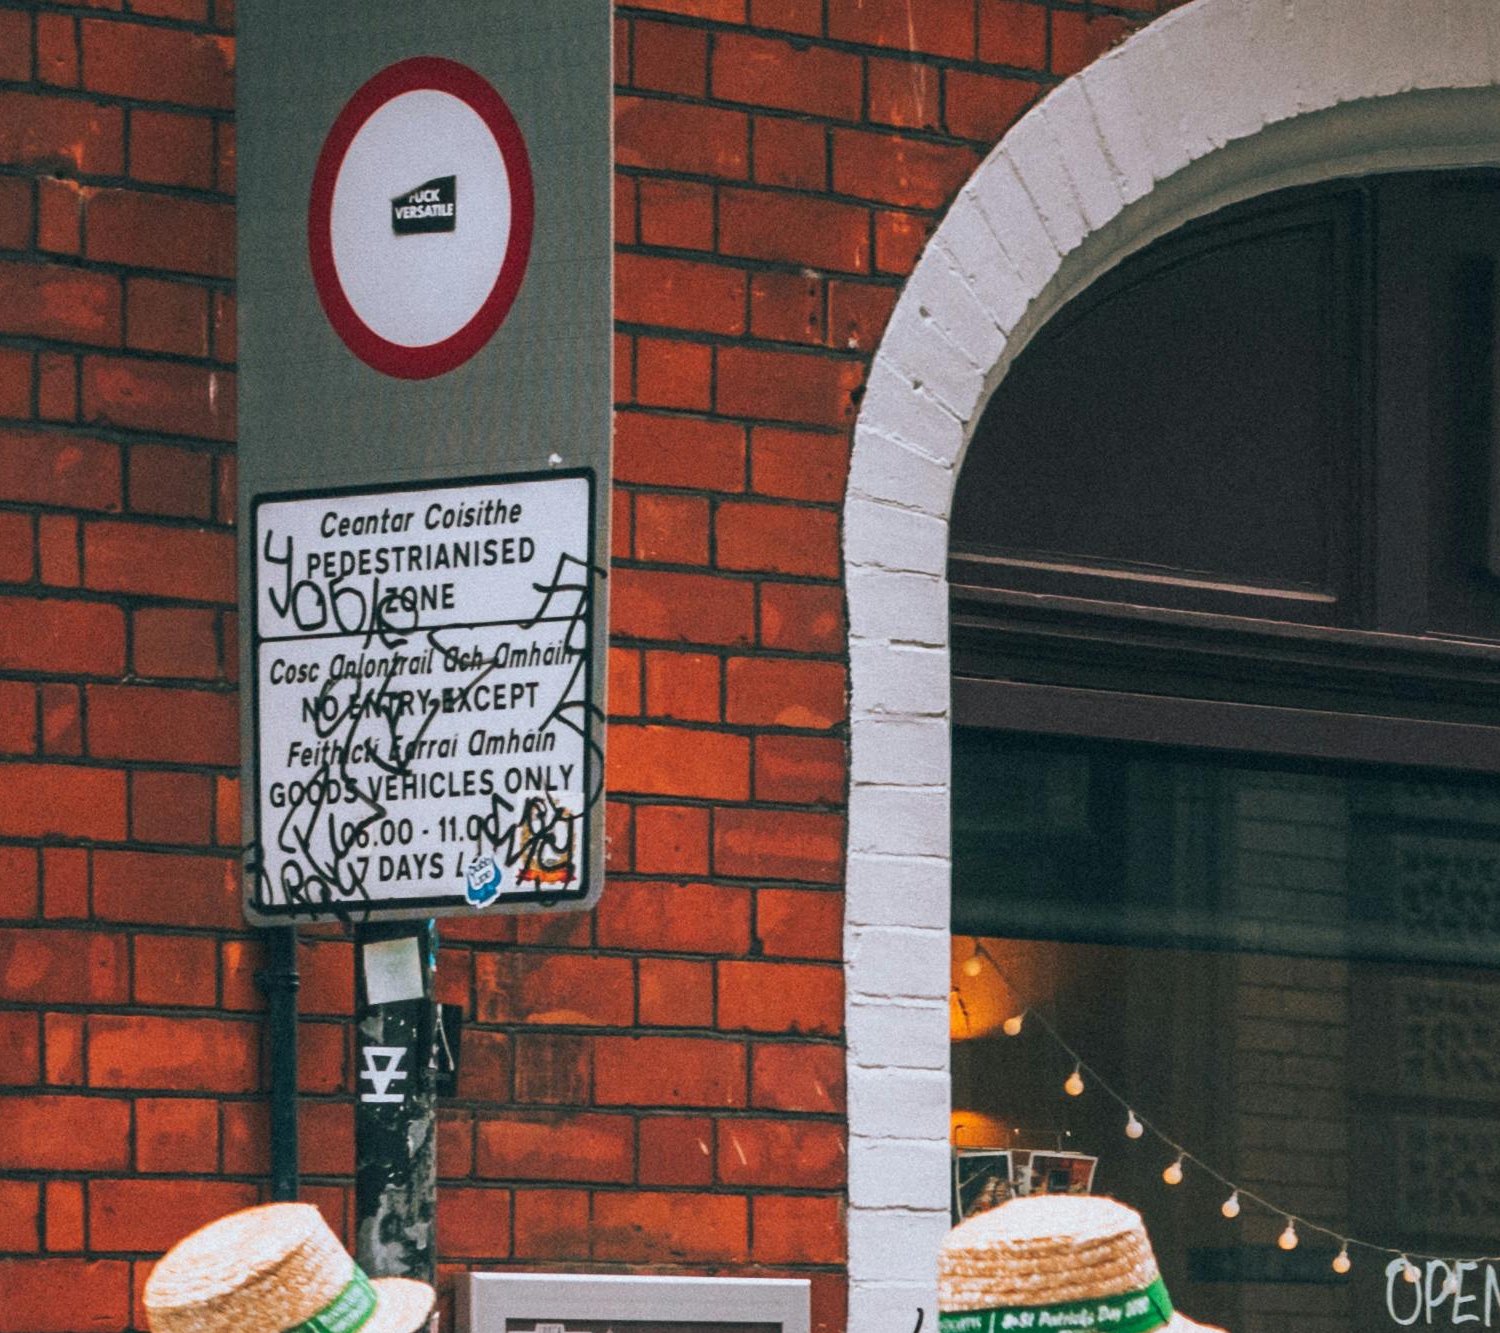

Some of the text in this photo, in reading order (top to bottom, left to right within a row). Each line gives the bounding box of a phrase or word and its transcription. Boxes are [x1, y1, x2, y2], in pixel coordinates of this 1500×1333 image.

[395, 203, 454, 219] VERSATILE
[320, 500, 523, 540] Ceantar Coisithe
[307, 536, 535, 580] PEDESTRIANISED
[384, 583, 455, 614] ZONE
[270, 658, 319, 685] Cosc
[302, 682, 540, 723] NO ENTRY EXCEPT
[270, 764, 575, 808] GOODS VEHICLES ONLY
[378, 853, 444, 882] DAYS
